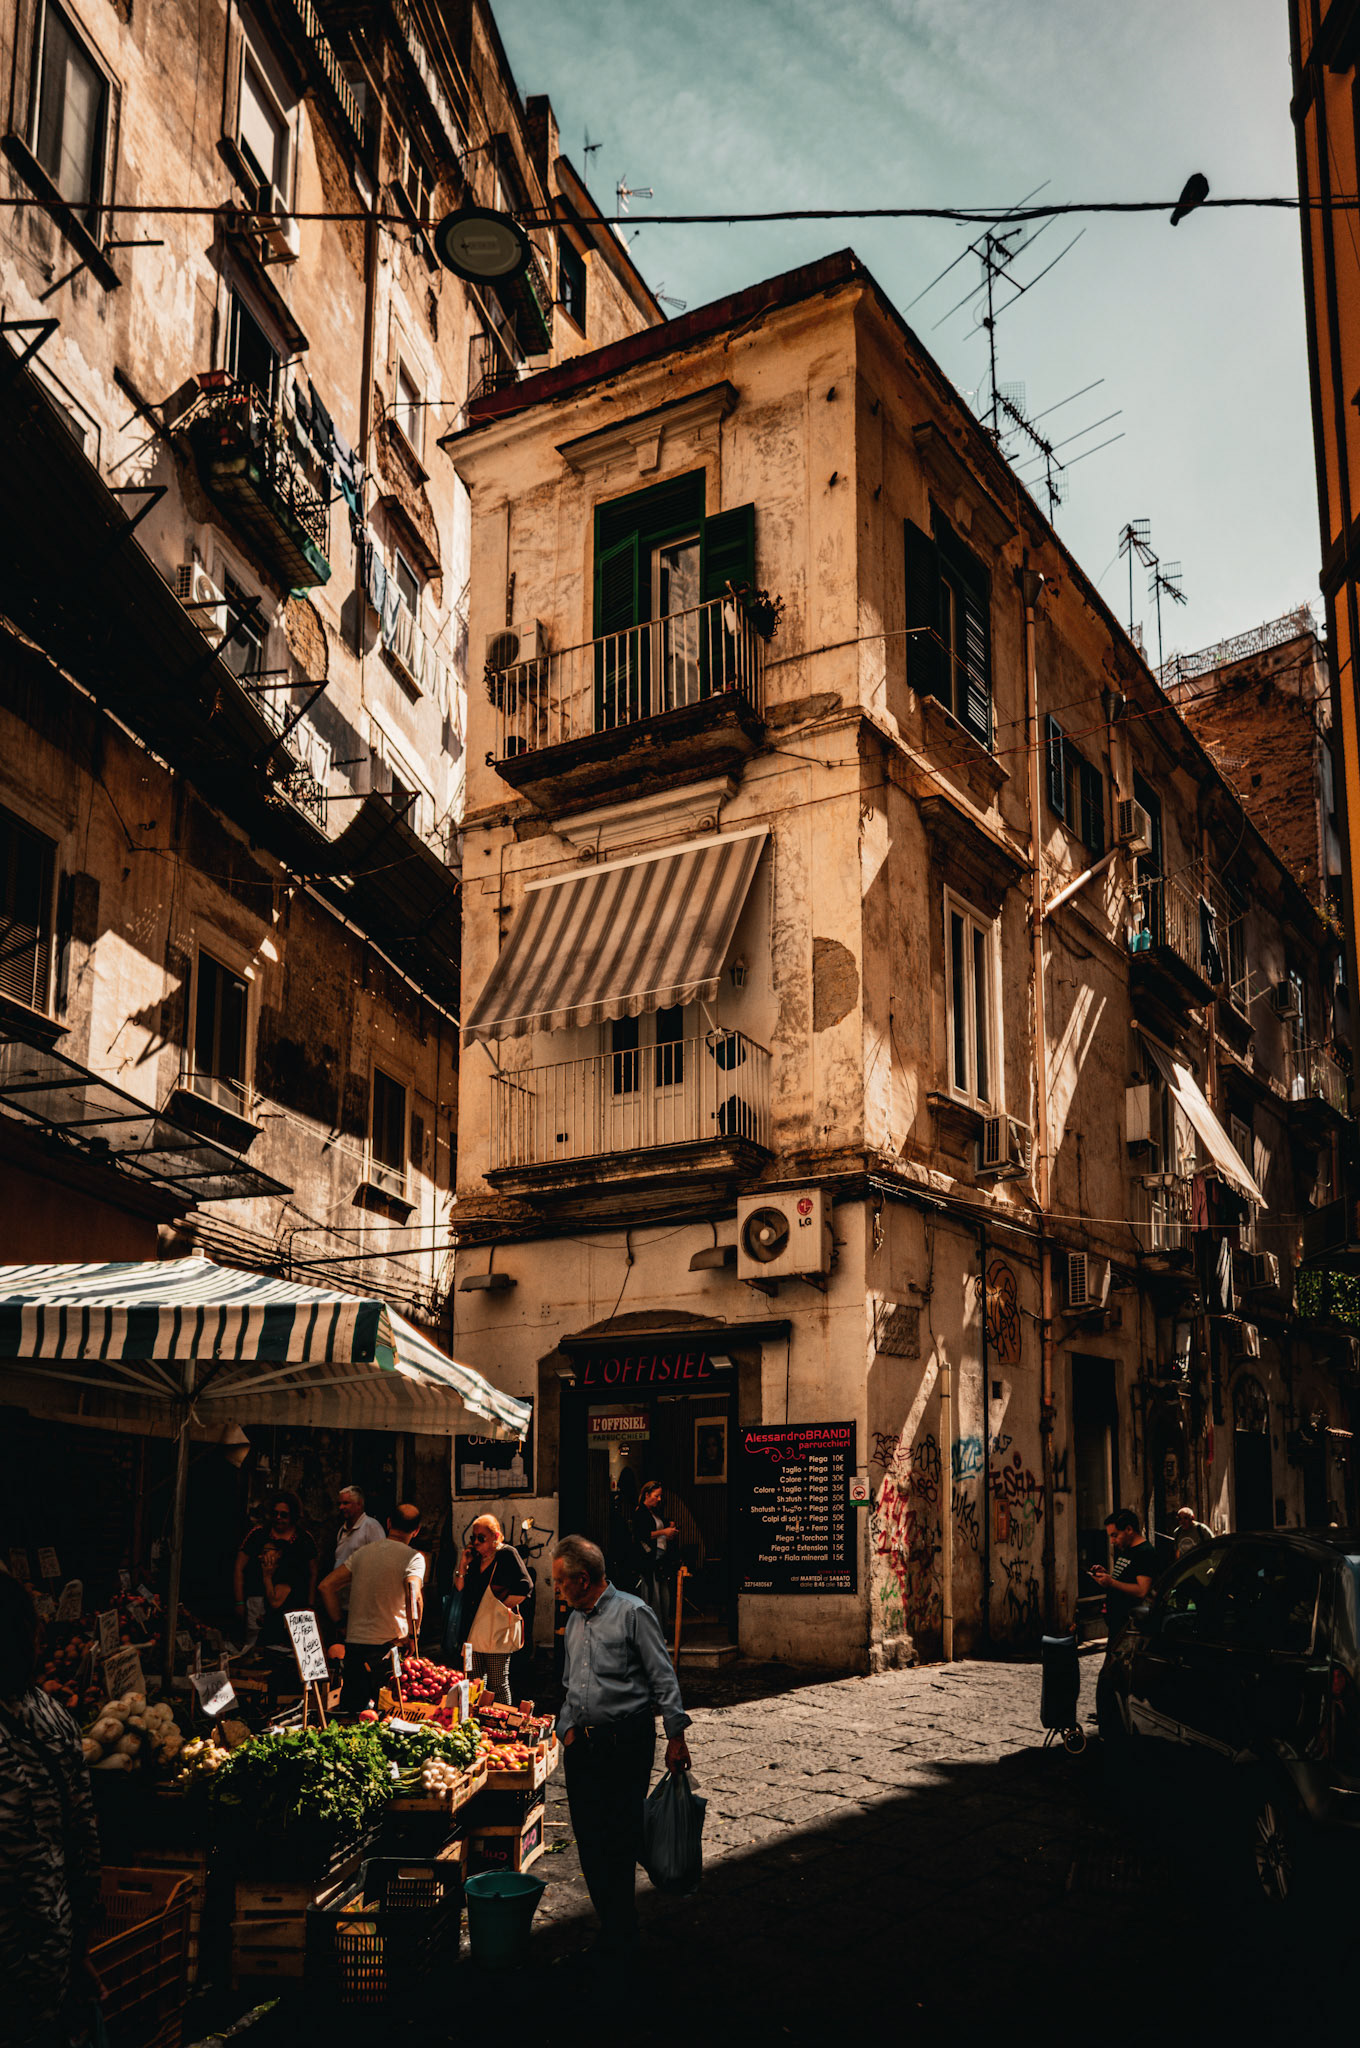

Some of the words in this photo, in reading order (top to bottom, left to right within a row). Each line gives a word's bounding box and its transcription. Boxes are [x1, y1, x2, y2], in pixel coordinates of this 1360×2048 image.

[799, 1217, 812, 1228] LG
[583, 1351, 711, 1385] L'OFFISIEL
[592, 1416, 646, 1432] L'OFFISIEL
[745, 1429, 850, 1442] AlessandroBRANDI
[798, 1440, 850, 1450] parrucchieri
[809, 1455, 828, 1463] Piega
[832, 1454, 844, 1462] 10€
[782, 1466, 802, 1474] Taglio
[809, 1465, 828, 1473] Piega
[832, 1464, 844, 1472] 18€
[809, 1475, 828, 1483] Piega
[832, 1474, 844, 1482] 30€
[753, 1486, 776, 1494] Colore
[782, 1486, 802, 1494] Taglio
[809, 1485, 828, 1493] Piega
[832, 1484, 844, 1492] 35€
[776, 1495, 802, 1503] Shatush
[809, 1495, 828, 1503] Piega
[832, 1494, 844, 1502] 50€
[751, 1505, 776, 1513] Shatush
[809, 1505, 828, 1513] Piega
[832, 1504, 844, 1512] 60€
[761, 1515, 780, 1523] Colpi
[809, 1514, 828, 1522] Piega
[832, 1513, 844, 1521] 50€
[832, 1523, 844, 1531] 15€
[775, 1534, 794, 1542] Piega
[832, 1533, 844, 1541] 13€
[770, 1544, 789, 1552] Piega
[832, 1543, 844, 1551] 15€
[758, 1554, 777, 1562] Piega
[832, 1553, 844, 1561] 15€
[800, 1573, 822, 1581] MARTEDÌ
